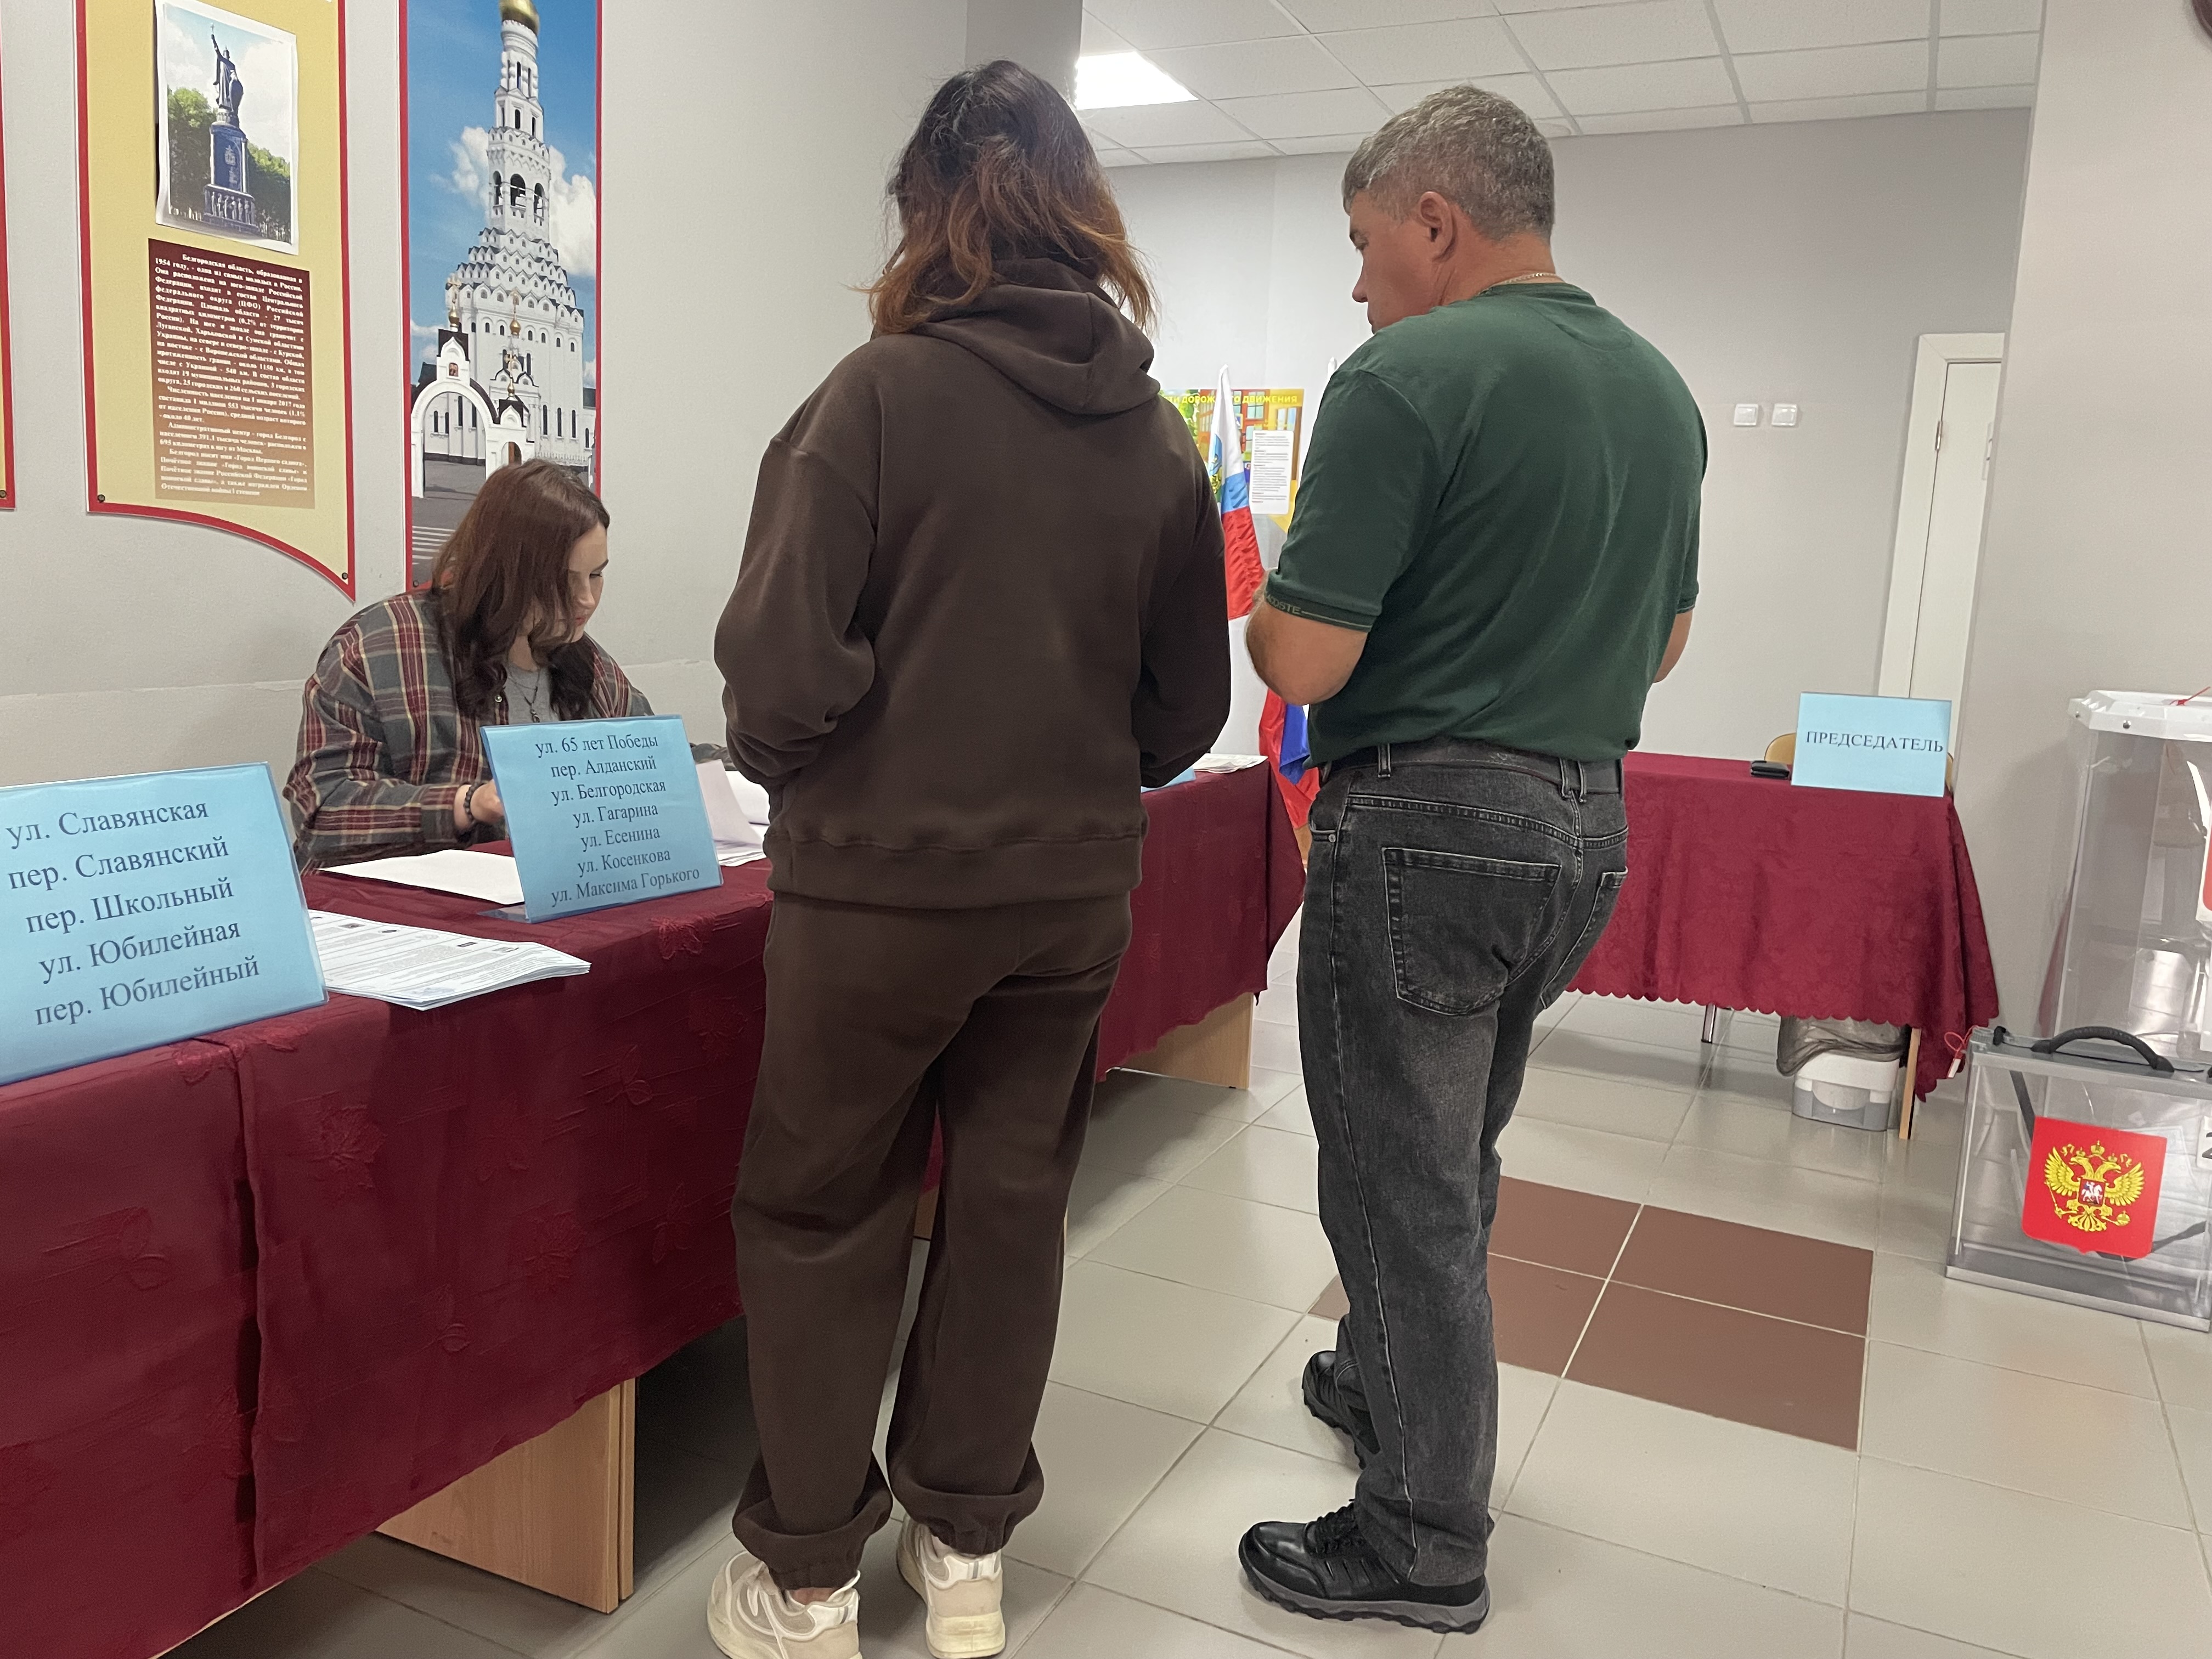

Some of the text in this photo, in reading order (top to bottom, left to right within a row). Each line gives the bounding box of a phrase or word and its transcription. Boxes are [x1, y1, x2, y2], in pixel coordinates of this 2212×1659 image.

[1181, 396, 1240, 404] ДОРОЖО
[1242, 396, 1297, 404] ДВИЖЕНИЯ
[535, 733, 658, 758] ул. 65 лет Победы
[1806, 731, 1943, 752] ПРЕДСЕДАТЕЛЬ
[550, 755, 657, 780] пер. Алданский
[551, 781, 666, 806] ул. Белгородская
[5, 803, 209, 850] ул. Славянская
[572, 805, 658, 828] ул. Гагарина
[580, 828, 661, 853] ул. Есенина
[8, 836, 229, 891] пер. Славянский
[577, 850, 671, 877] ул. Косенкова
[551, 869, 700, 908] ул. Максима Горького
[25, 876, 234, 934] пер. Школьный
[38, 923, 241, 984] ул. Юбилейная
[35, 955, 260, 1025] пер. Юбилейный
